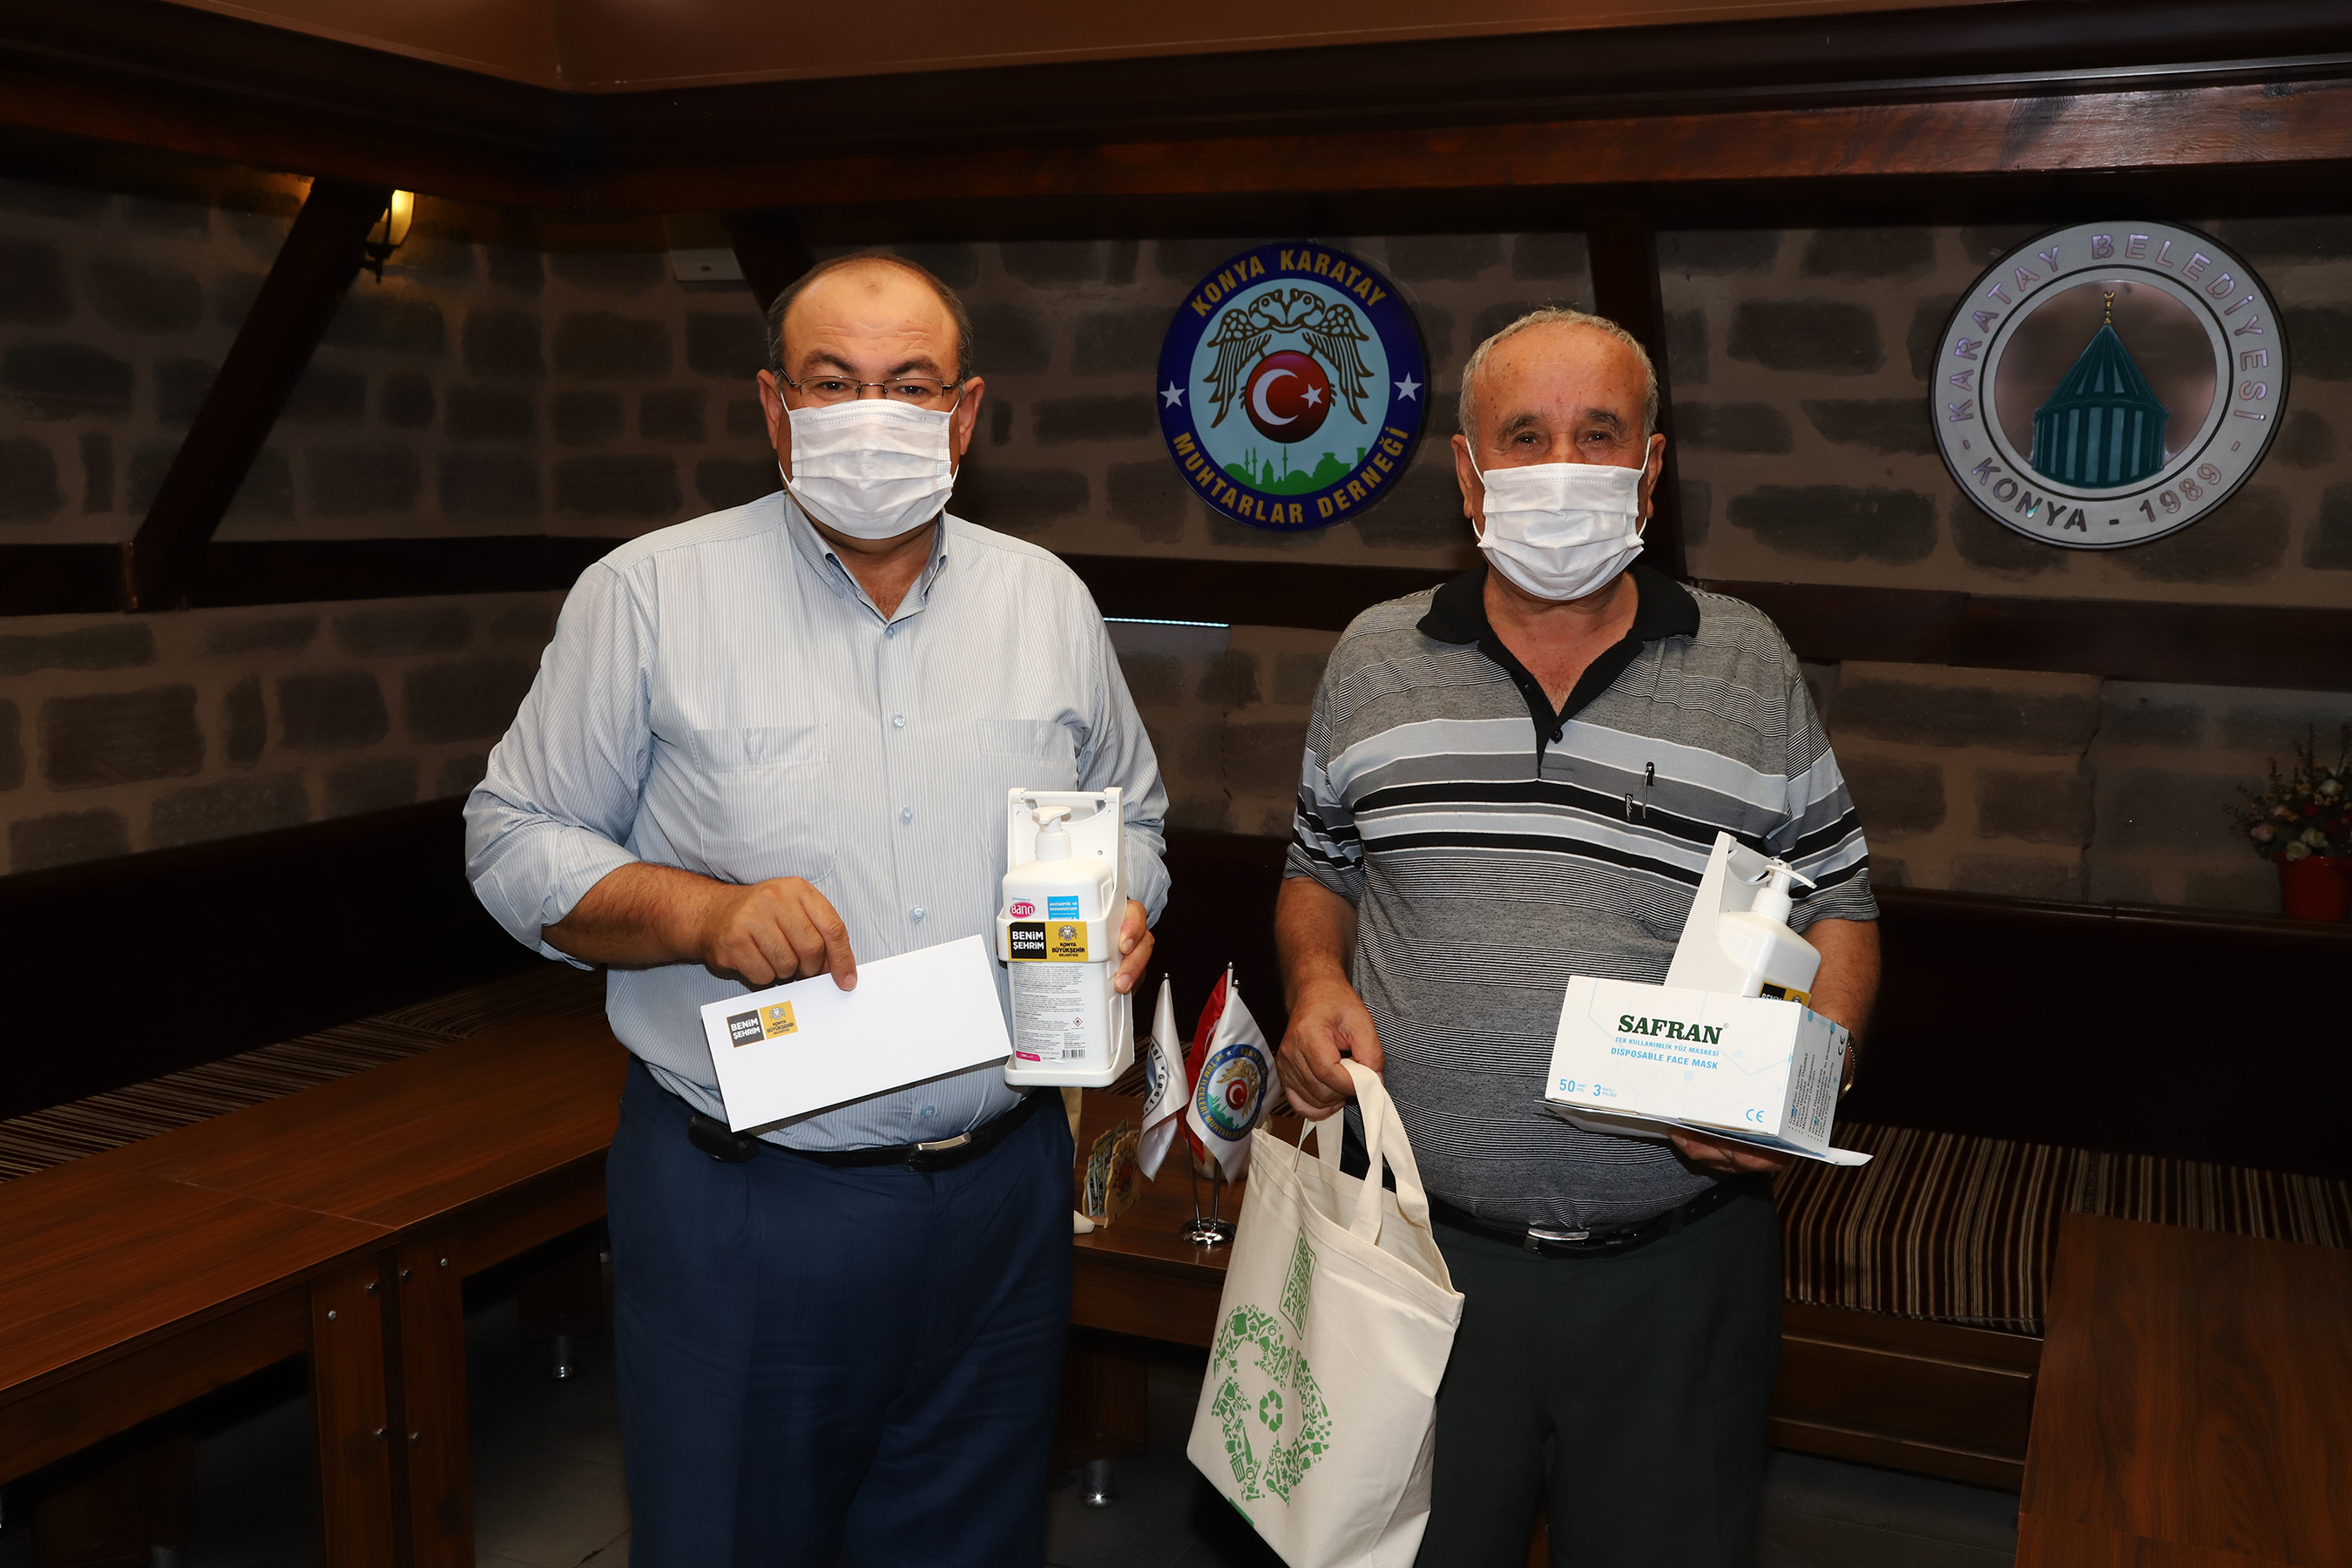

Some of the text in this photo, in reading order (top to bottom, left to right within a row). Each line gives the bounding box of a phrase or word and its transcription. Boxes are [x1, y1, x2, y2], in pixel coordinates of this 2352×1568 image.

[1191, 249, 1387, 316] KONYA KARATAY
[1949, 233, 2268, 422] KARATAY BELEDİYESİ
[1173, 426, 1409, 523] MUHTARLAR DERNEĞİ
[1971, 457, 2087, 532] KONYA
[2139, 463, 2222, 523] 1989
[1618, 1014, 1723, 1044] SAFRAN
[1611, 1047, 1719, 1070] DISPOSABLE FACE MASK
[1628, 1038, 1673, 1050] KULLANIMLIK
[1673, 1044, 1687, 1052] YÜZ
[1688, 1047, 1720, 1057] MASKESİ
[1150, 1074, 1166, 1105] 1989
[1559, 1078, 1576, 1092] 50
[1592, 1084, 1601, 1097] 3
